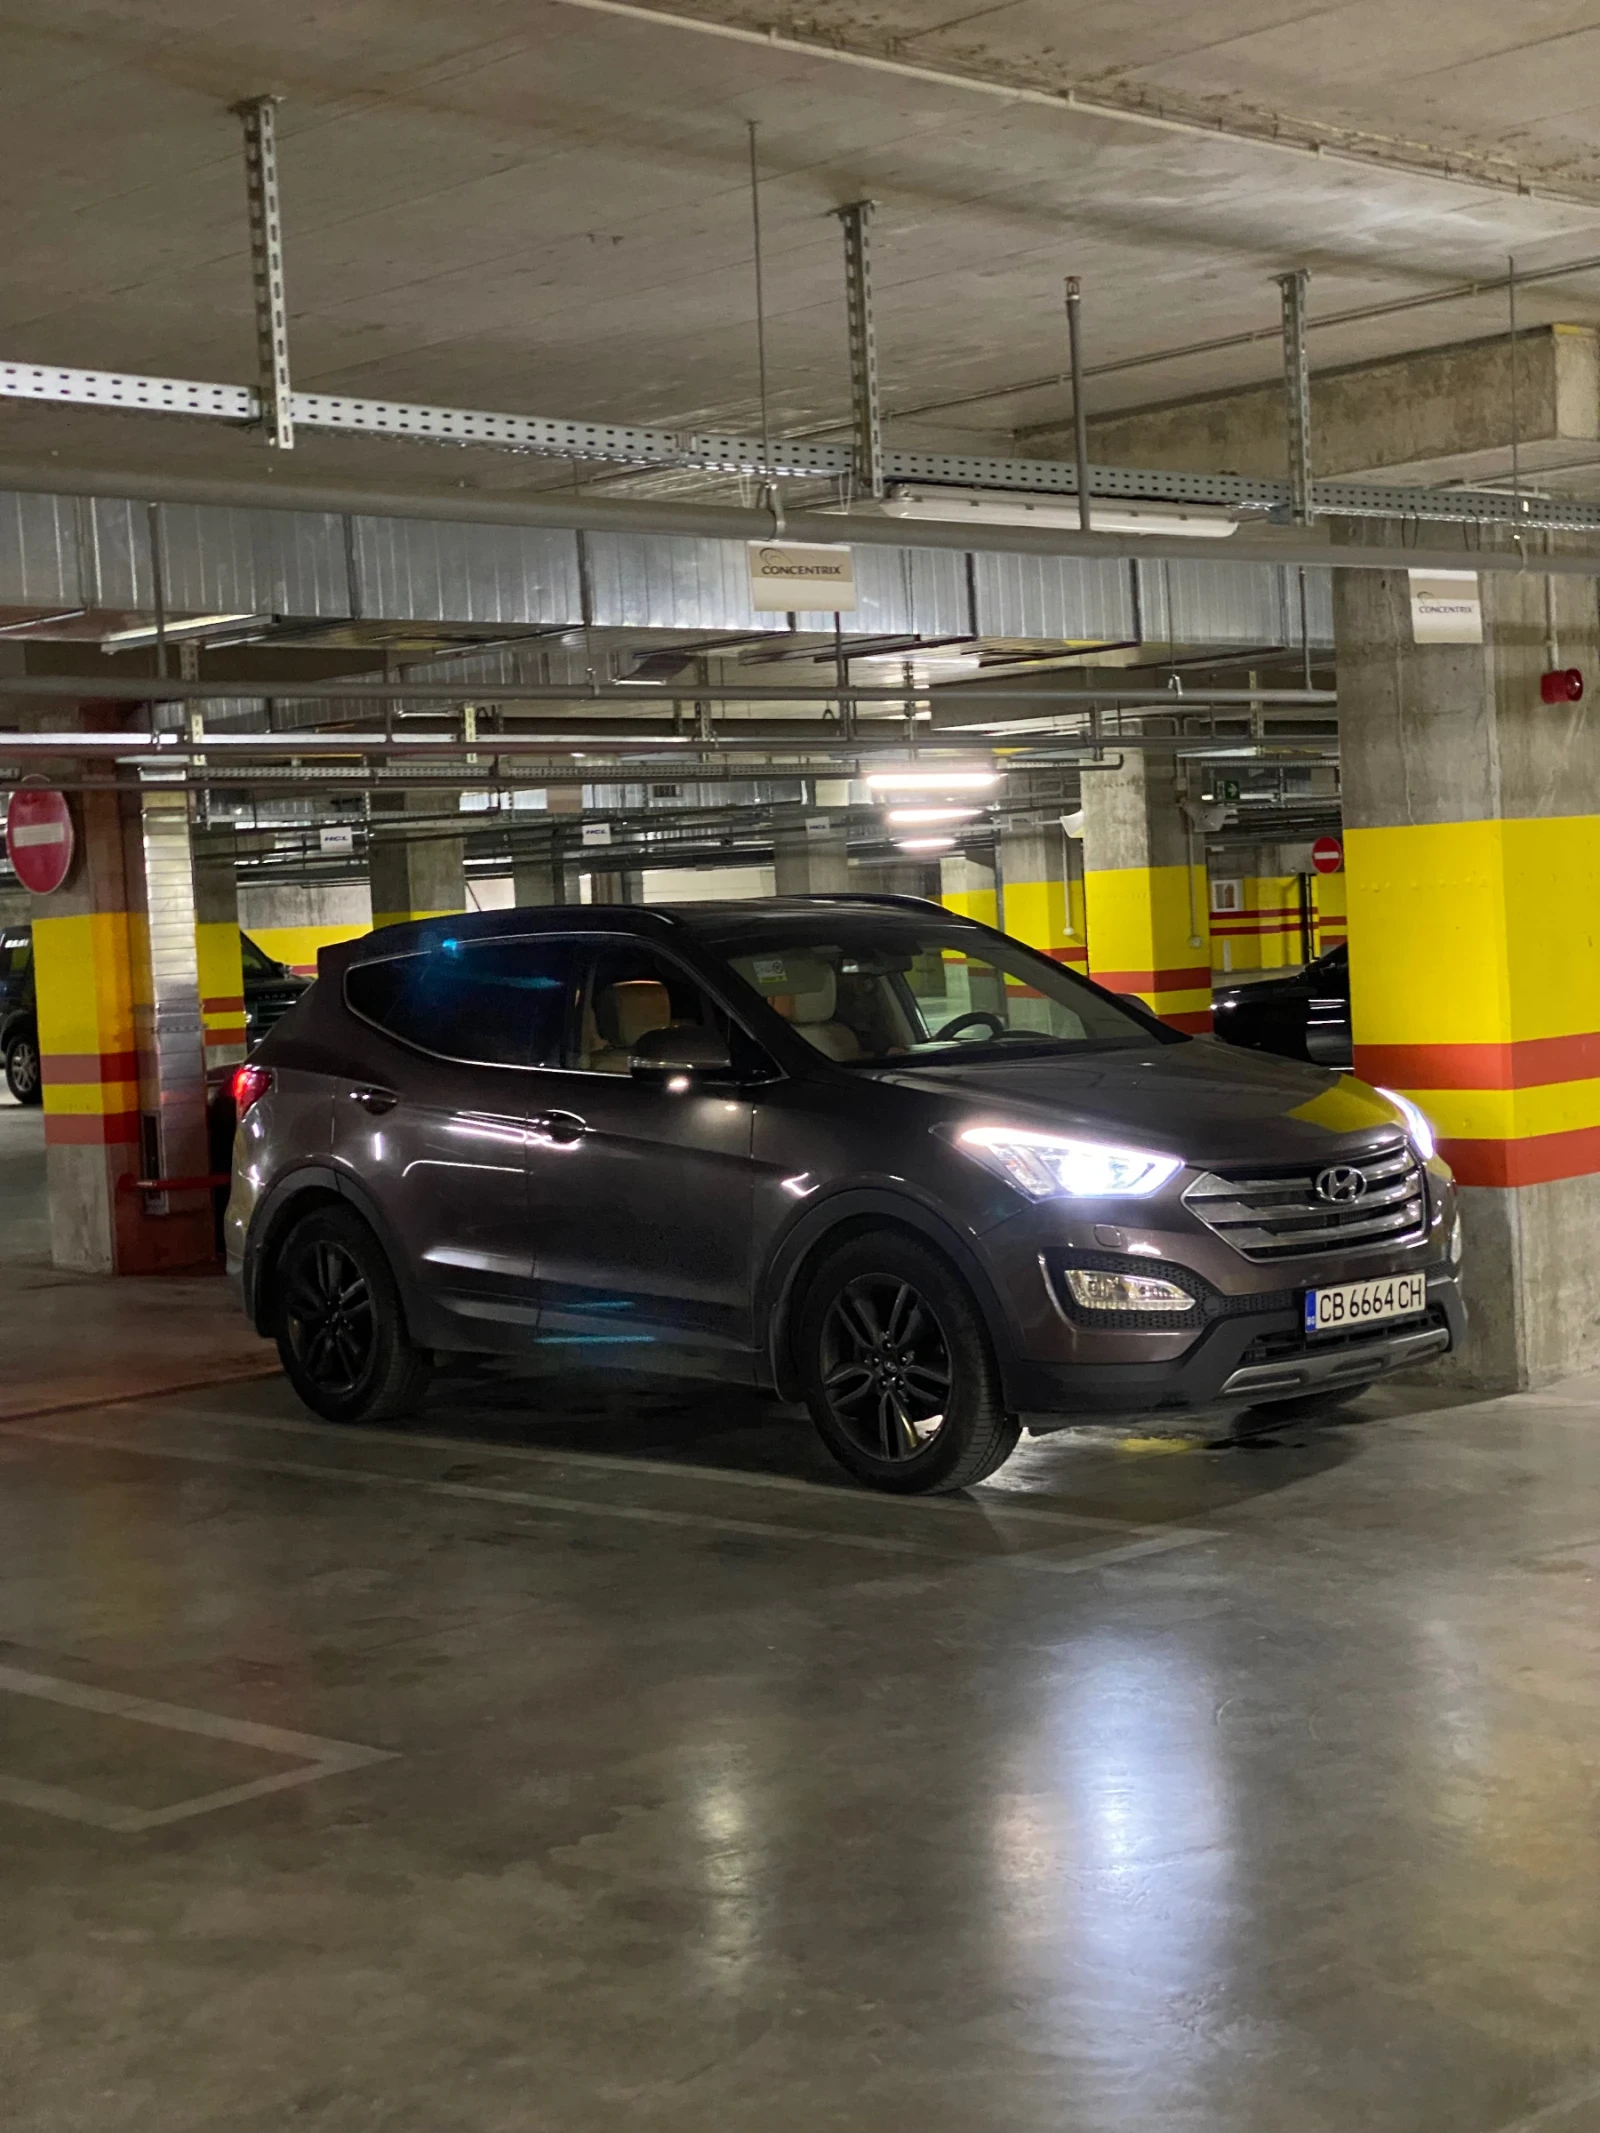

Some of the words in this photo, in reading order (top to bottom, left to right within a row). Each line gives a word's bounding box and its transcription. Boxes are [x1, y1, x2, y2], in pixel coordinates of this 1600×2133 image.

[761, 565, 842, 575] CONCENTRIX
[1319, 1292, 1345, 1323] CB
[1349, 1283, 1395, 1318] 6664
[1397, 1278, 1423, 1309] CH
